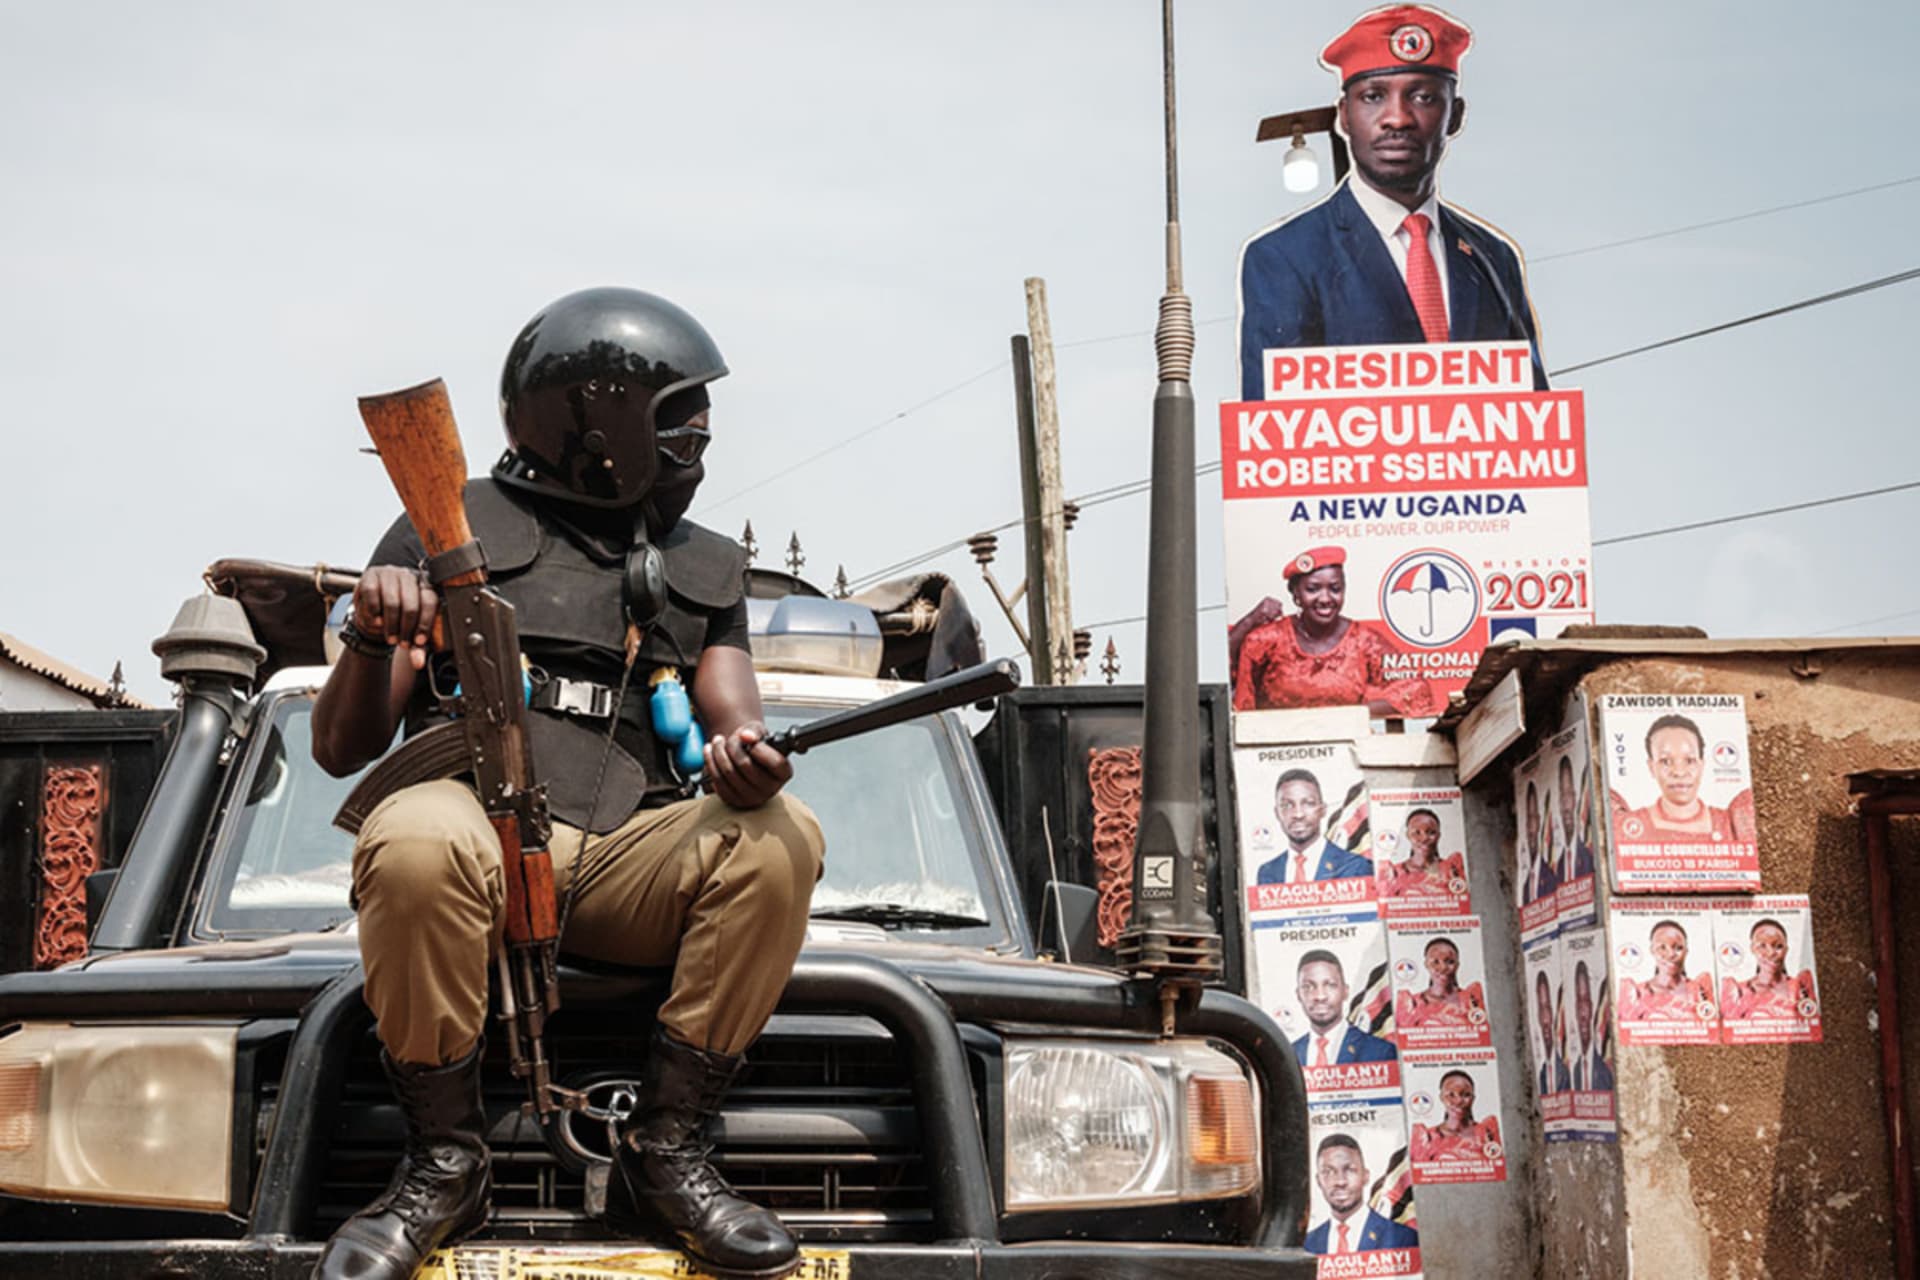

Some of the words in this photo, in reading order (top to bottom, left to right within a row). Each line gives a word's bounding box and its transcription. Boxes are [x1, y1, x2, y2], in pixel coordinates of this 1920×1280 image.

[1272, 349, 1529, 391] PRESIDENT
[1238, 400, 1571, 451] KYAGULANYI
[1237, 455, 1374, 488] ROBERT
[1382, 449, 1575, 483] SSENTAMU
[1290, 501, 1310, 522] A
[1320, 498, 1387, 520] NEW
[1396, 494, 1527, 517] UGANDA
[1308, 524, 1361, 538] PEOPLE
[1424, 520, 1456, 534] OUR
[1458, 519, 1510, 533] POWER
[1484, 558, 1587, 569] MISSION
[1486, 570, 1587, 611] 2021
[1384, 670, 1419, 680] UNITY
[1423, 669, 1473, 679] PLATFOR
[1608, 696, 1673, 708] ZAWEDDE
[1258, 747, 1336, 762] PRESIDENT
[1615, 733, 1627, 777] VOTE
[1633, 859, 1681, 869] BUKOTO
[1258, 880, 1366, 899] KYAGULANYI
[1280, 926, 1357, 941] PRESIDENT
[1304, 1064, 1389, 1080] AGULANYI
[1312, 1110, 1376, 1125] RESIDENT
[1318, 1251, 1410, 1269] AGULANYI
